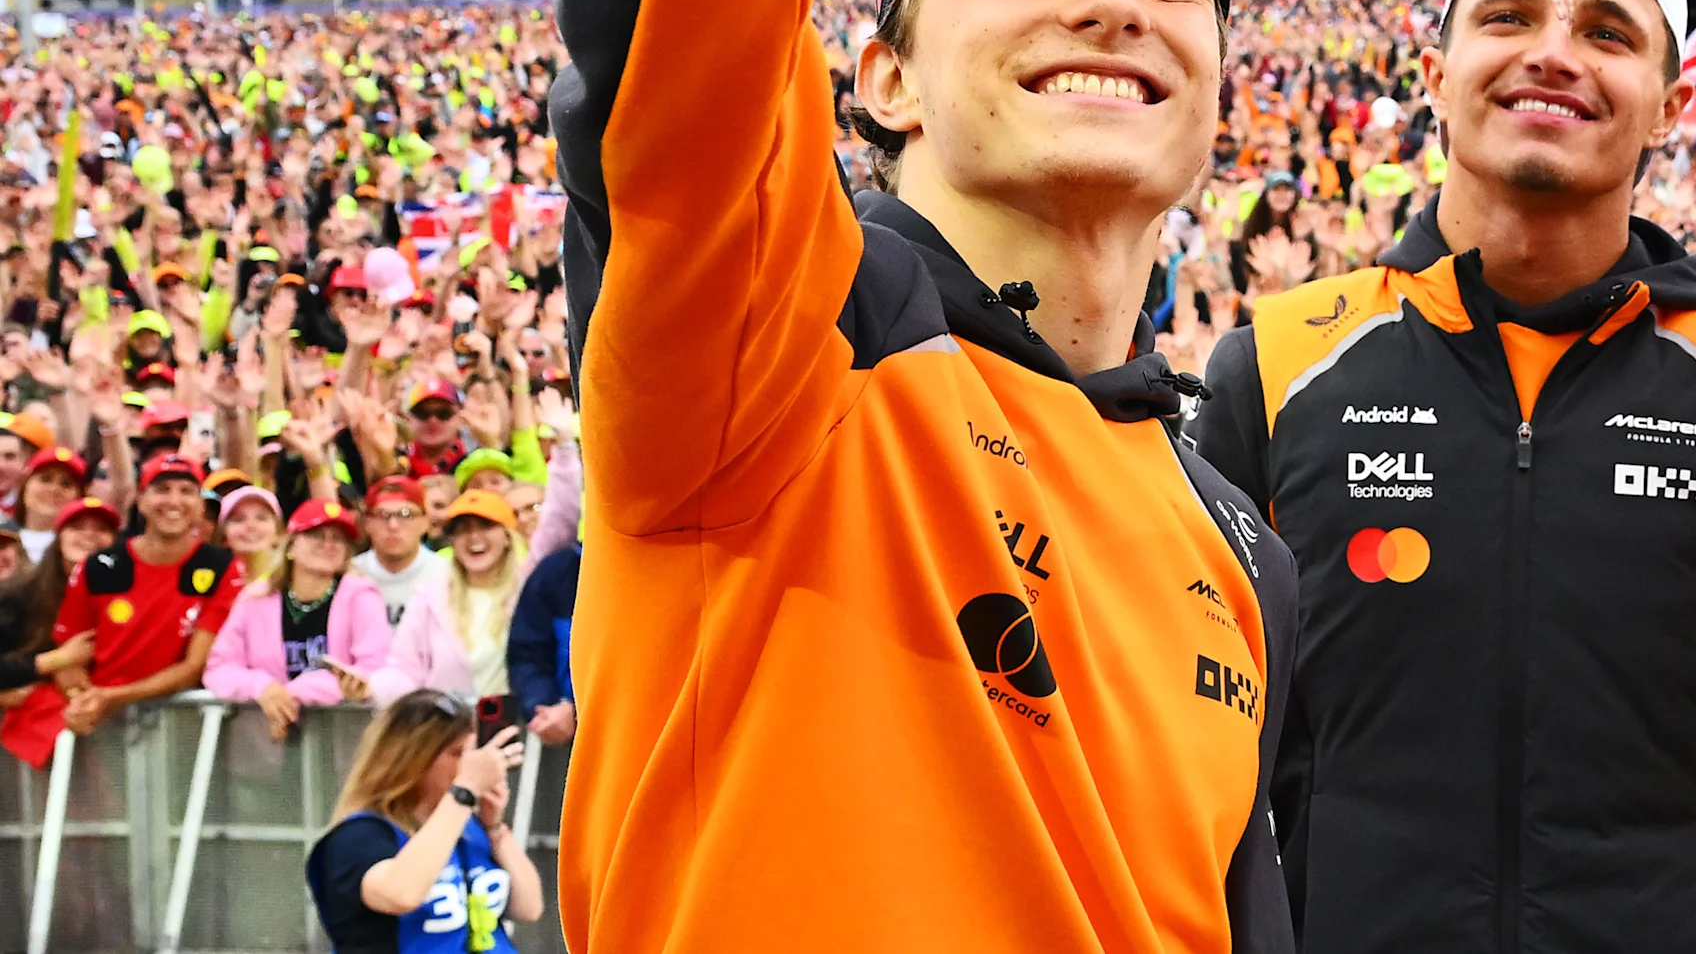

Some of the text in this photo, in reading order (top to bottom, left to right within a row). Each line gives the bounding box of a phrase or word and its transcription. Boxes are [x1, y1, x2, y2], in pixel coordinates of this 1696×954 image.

[1341, 405, 1409, 423] Android
[1626, 432, 1672, 445] FORMULA
[1347, 451, 1434, 482] DELL
[1347, 483, 1434, 501] Technologies
